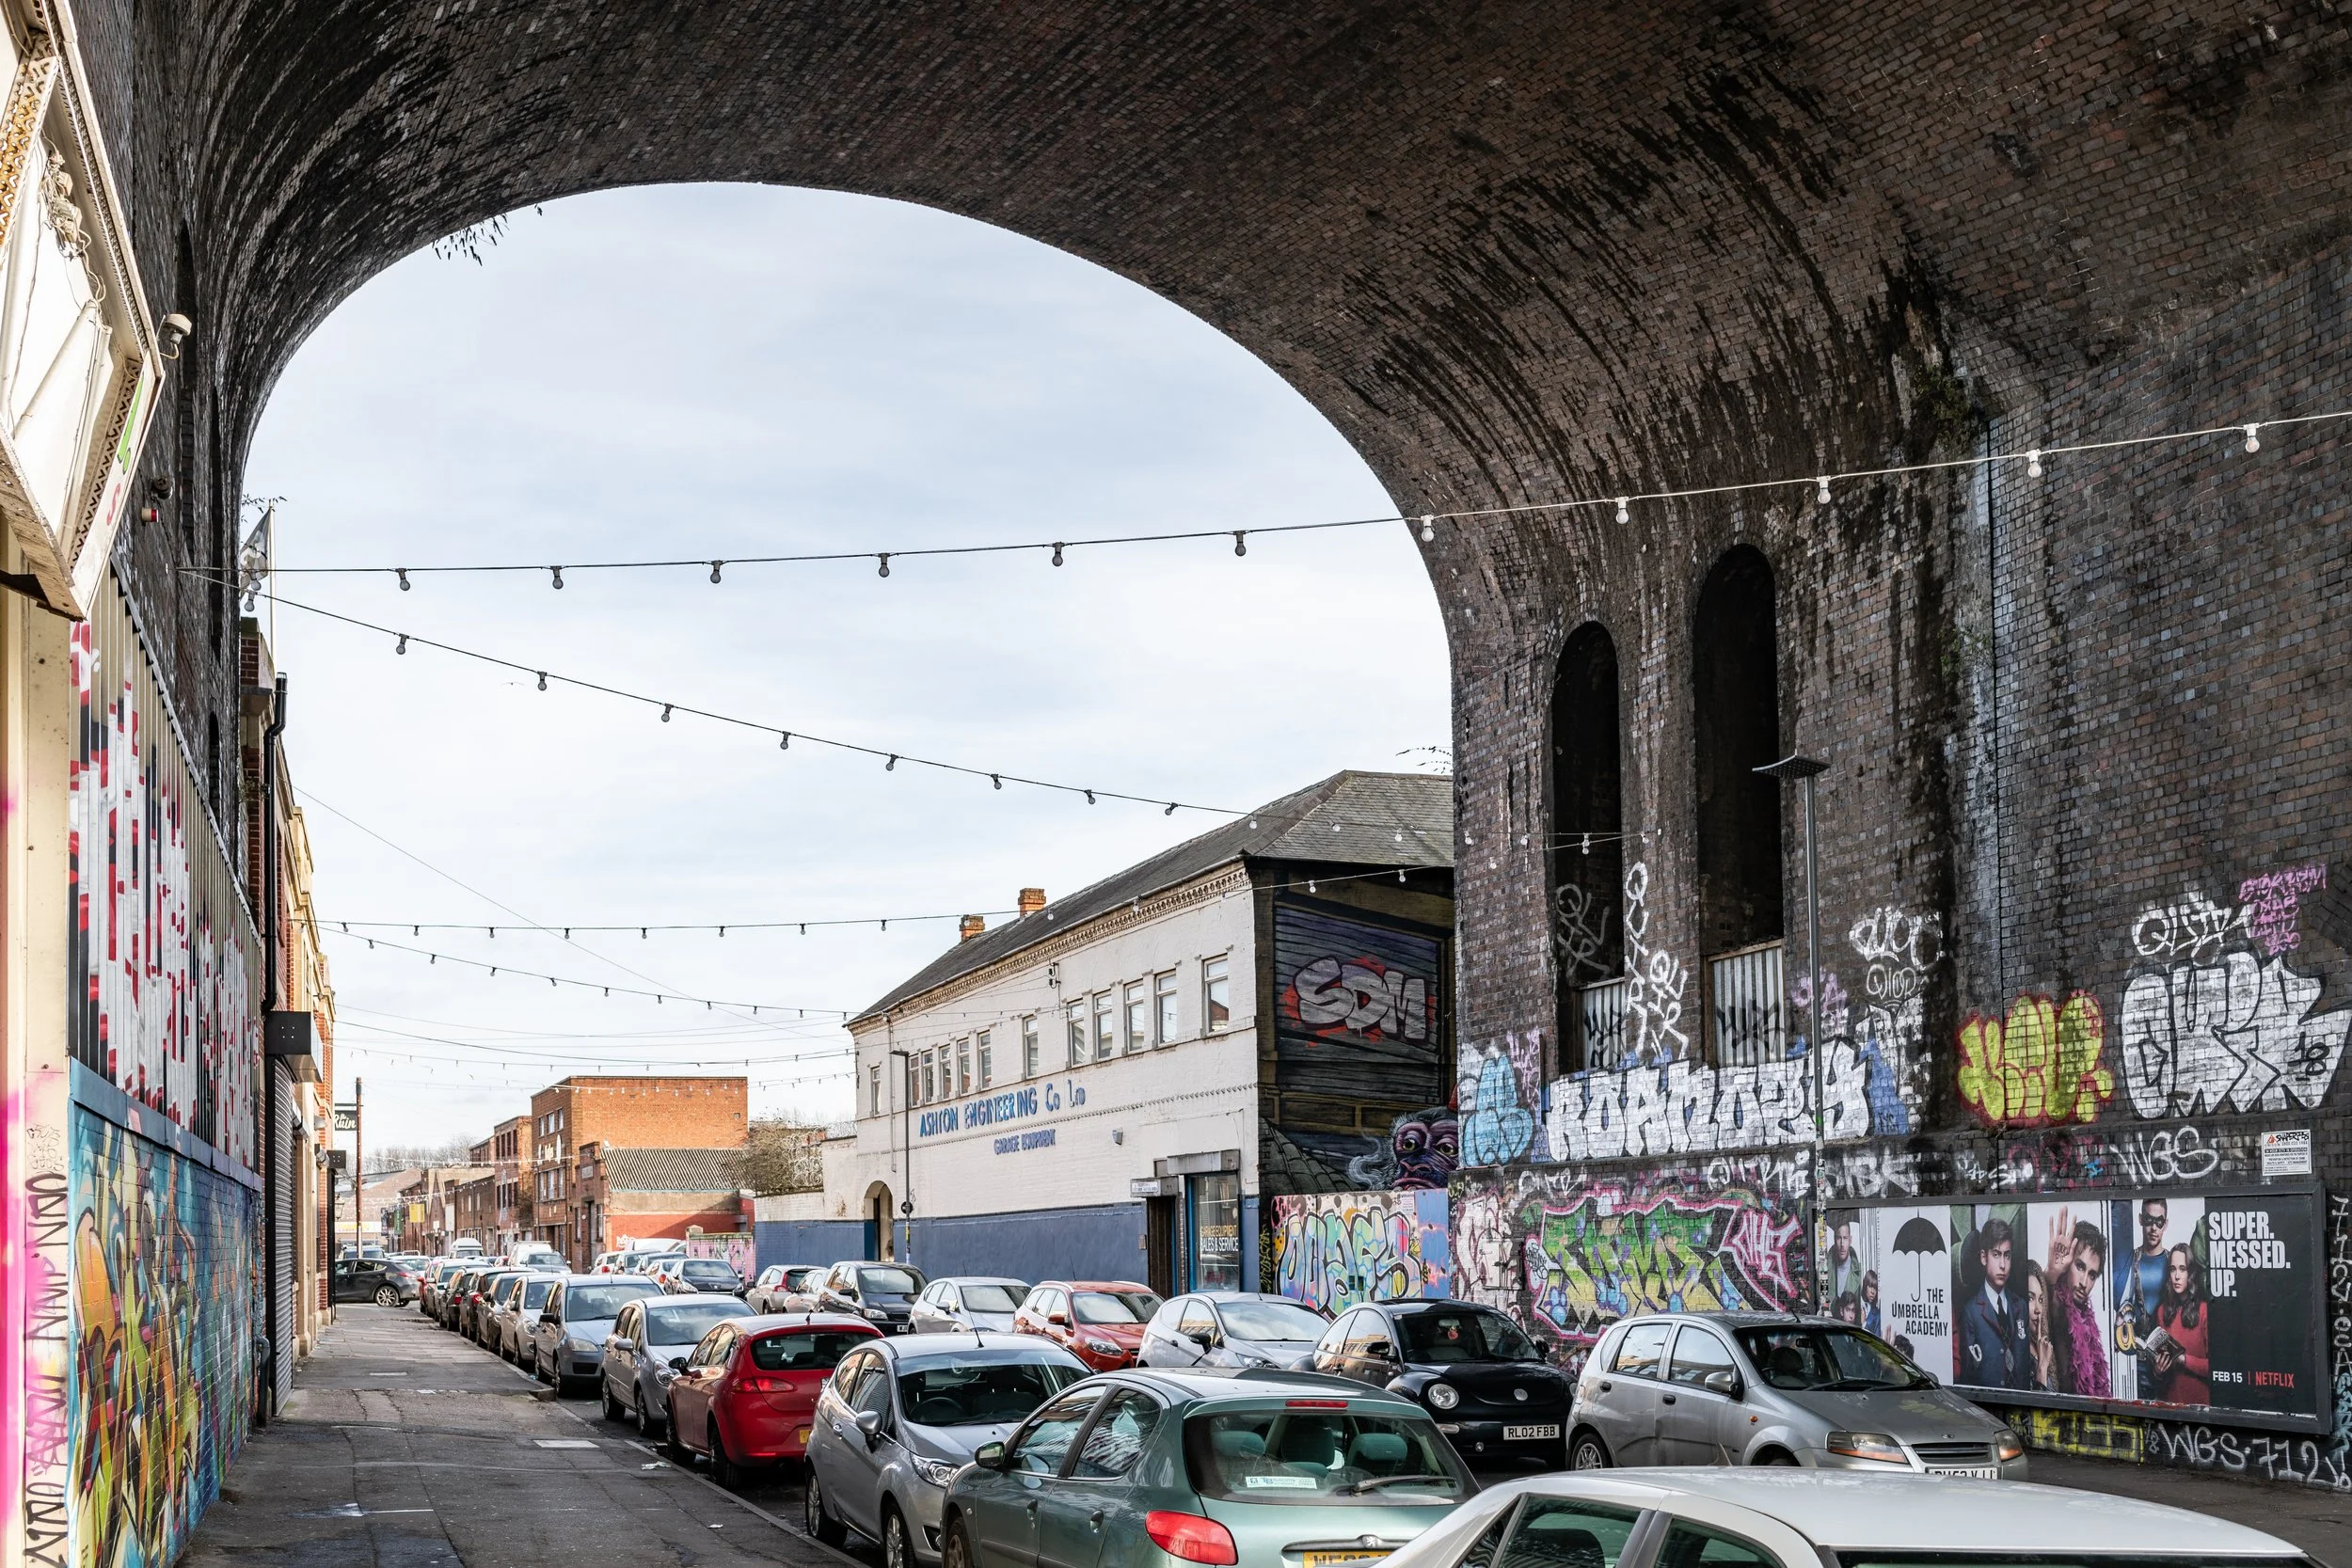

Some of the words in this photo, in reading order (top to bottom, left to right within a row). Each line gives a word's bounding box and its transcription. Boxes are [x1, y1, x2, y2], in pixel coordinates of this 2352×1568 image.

[1293, 955, 1429, 1044] SDM
[919, 1106, 959, 1137] ASHTON
[963, 1087, 1038, 1130] ENGINEERING
[334, 1115, 357, 1129] Ruin
[993, 1134, 1019, 1155] GARAGE
[1021, 1129, 1056, 1150] EQUIPMENT
[2208, 1211, 2275, 1240] SUPER.
[1218, 1238, 1239, 1251] SERVICE
[2209, 1240, 2291, 1269] MESSED.
[2210, 1269, 2237, 1297] UP.
[1927, 1288, 1944, 1303] THE
[1891, 1301, 1939, 1319] UMBRELLA
[1905, 1320, 1947, 1337] ACADEMY
[2212, 1370, 2231, 1382] FEB
[2232, 1371, 2243, 1383] 15
[2255, 1371, 2295, 1388] NETFLIX
[1507, 1427, 1534, 1438] RL02
[1536, 1426, 1555, 1436] FBB
